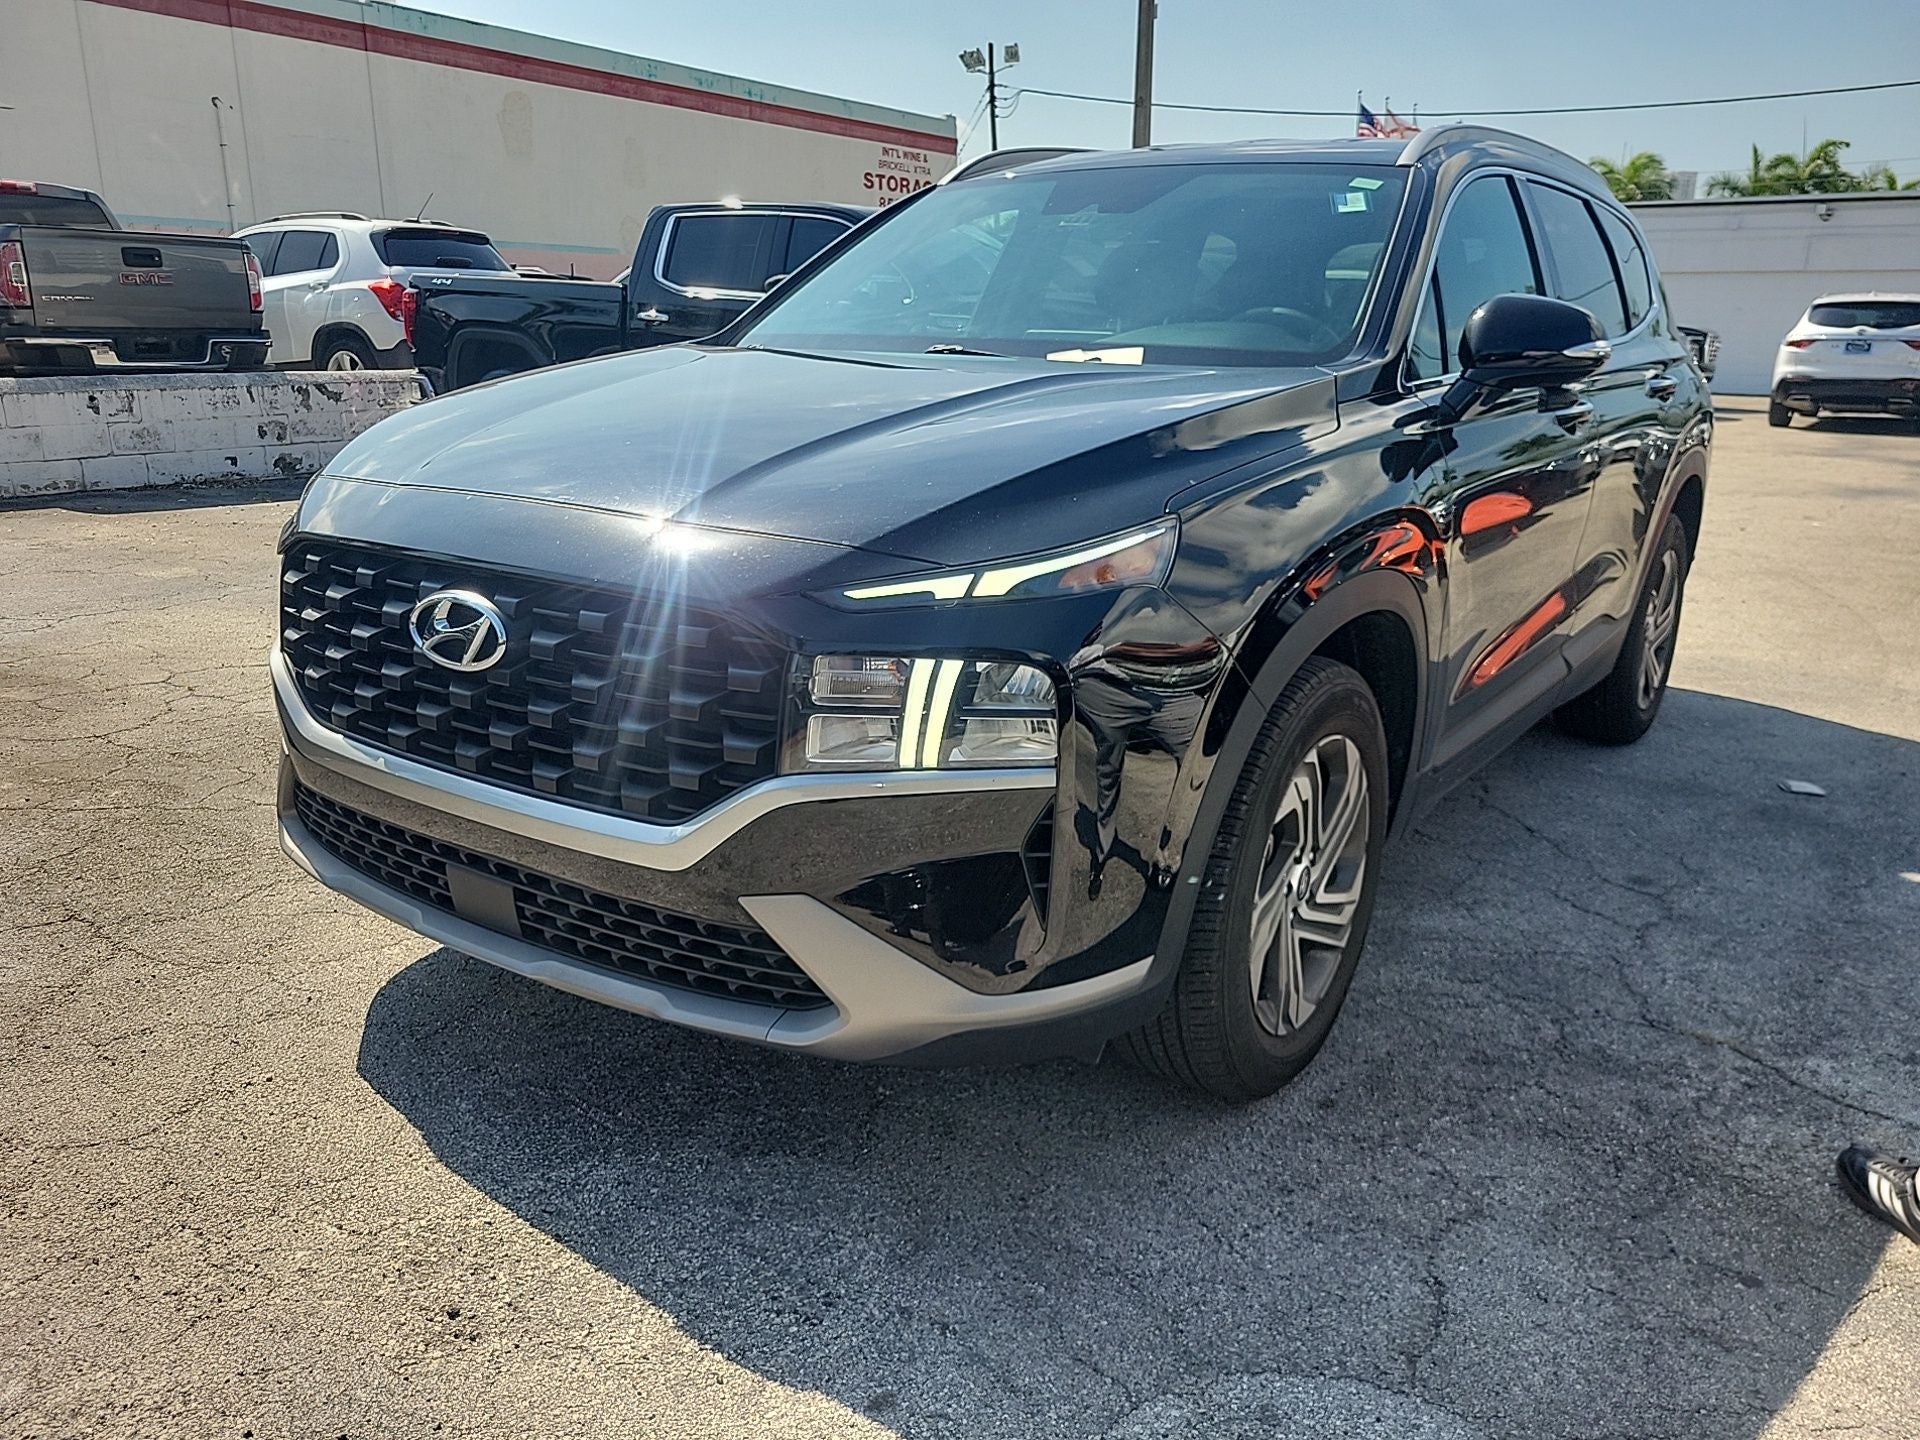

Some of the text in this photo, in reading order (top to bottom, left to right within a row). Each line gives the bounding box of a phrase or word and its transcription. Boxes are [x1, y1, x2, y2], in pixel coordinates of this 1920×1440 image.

[902, 150, 921, 162] WINE
[878, 159, 932, 176] BRICKELL XTRA
[119, 271, 175, 285] GMC
